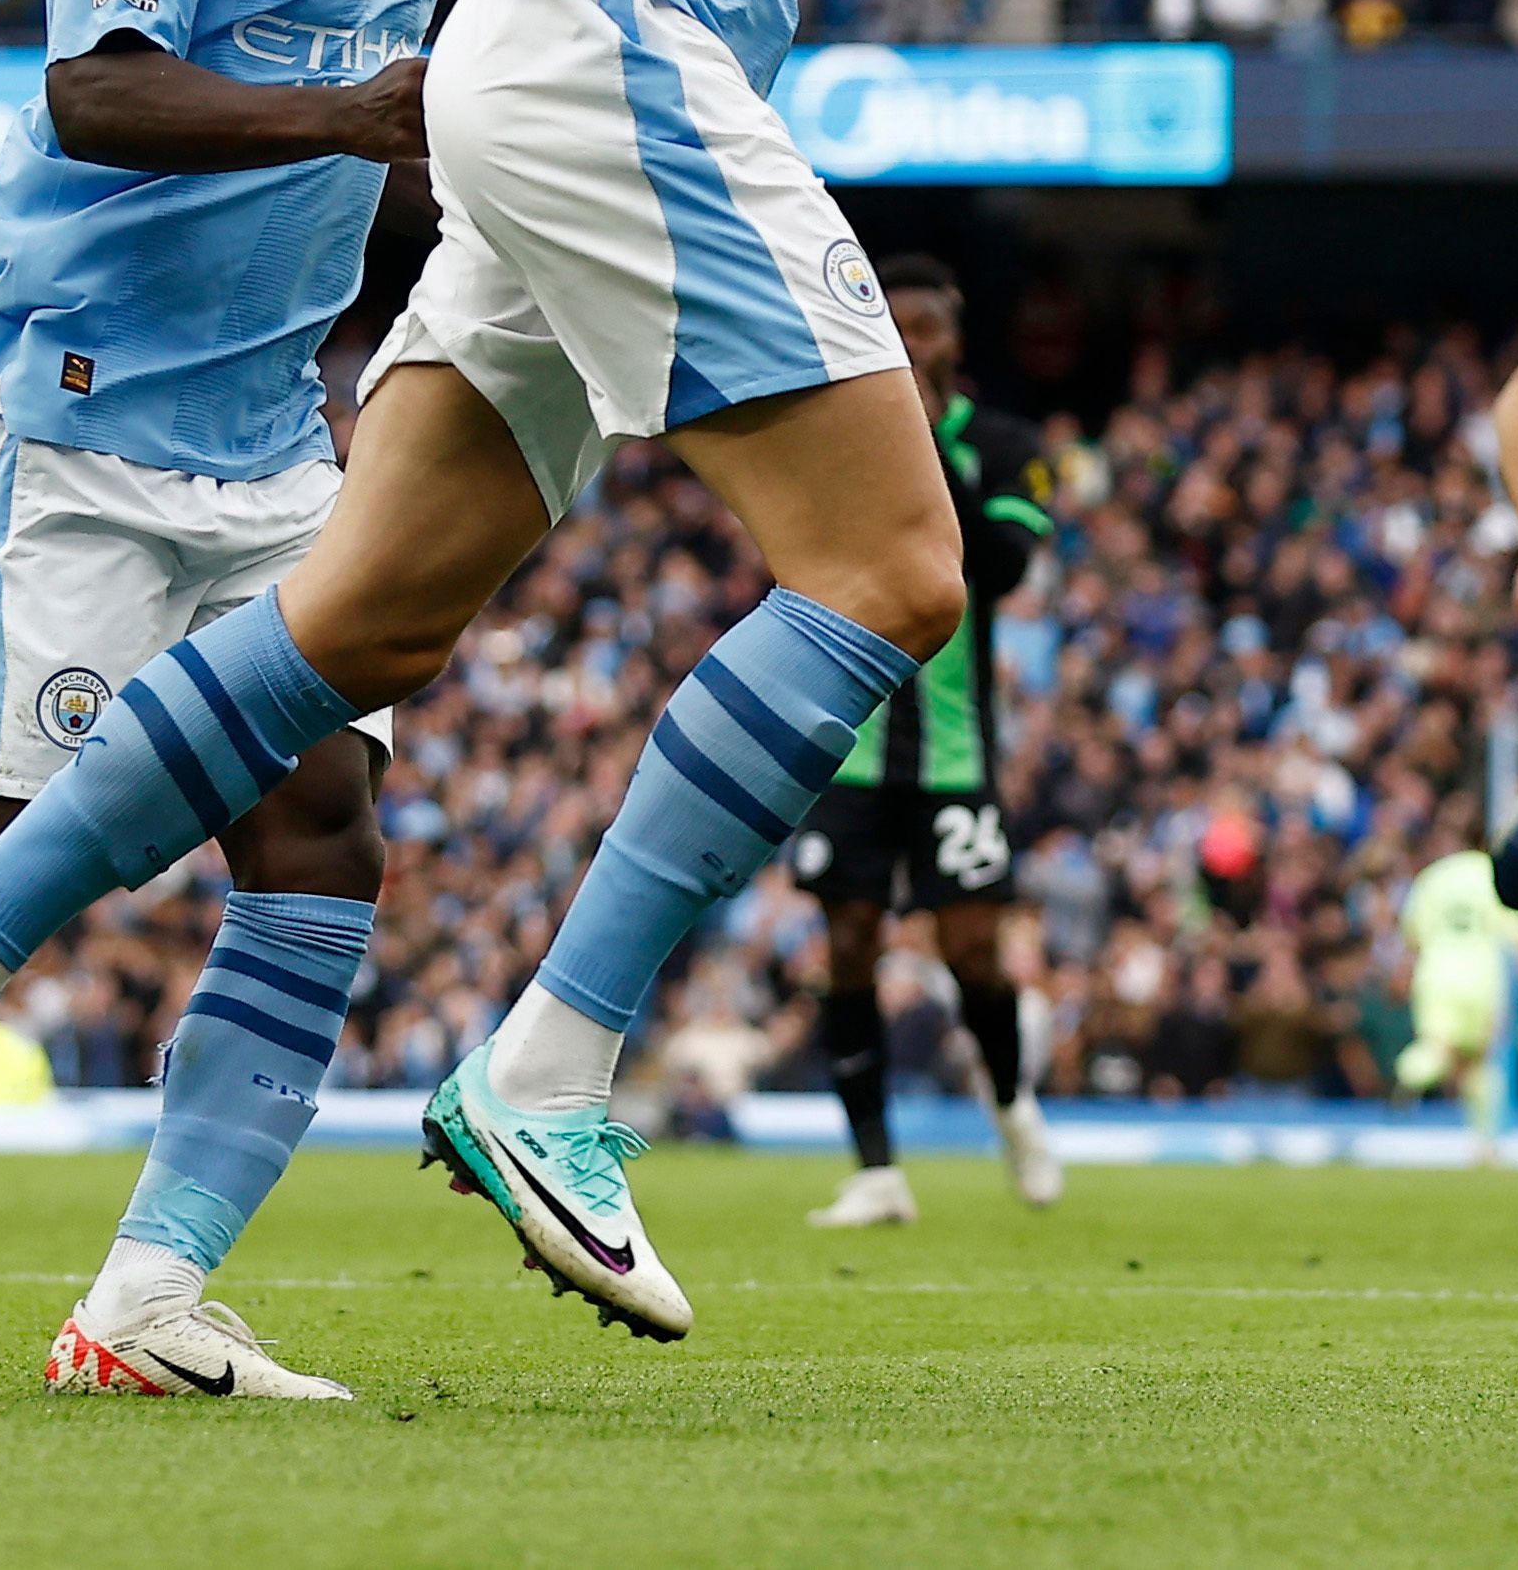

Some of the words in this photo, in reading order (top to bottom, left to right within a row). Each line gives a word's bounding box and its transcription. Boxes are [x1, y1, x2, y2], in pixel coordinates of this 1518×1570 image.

[233, 14, 423, 71] ETIHA
[47, 674, 107, 702] MANCHESTER
[253, 1073, 317, 1110] CIT
